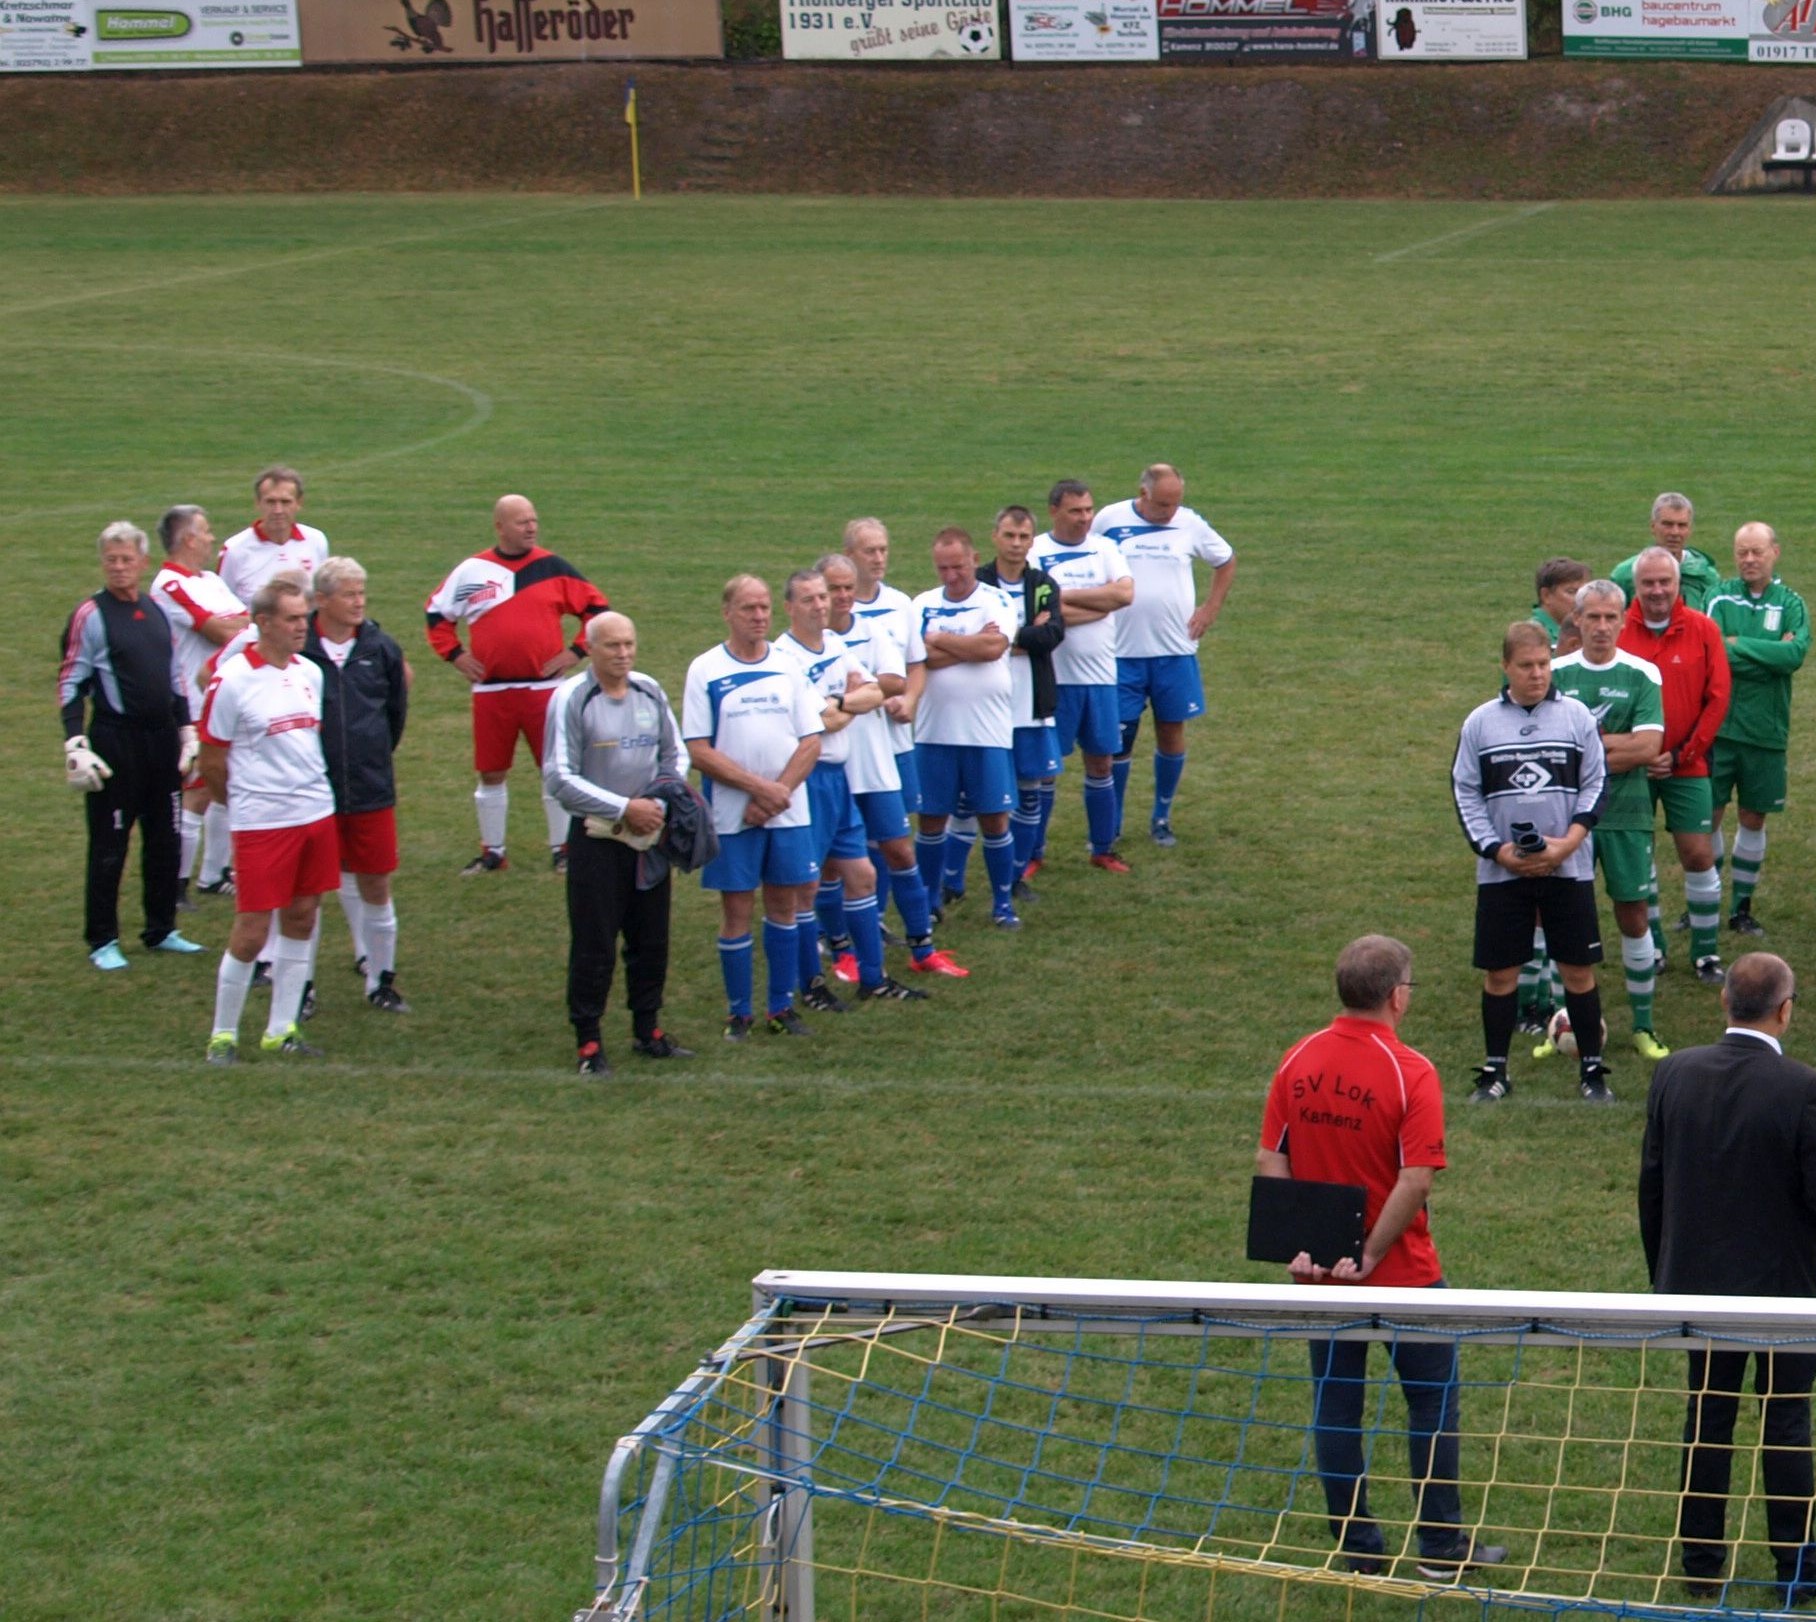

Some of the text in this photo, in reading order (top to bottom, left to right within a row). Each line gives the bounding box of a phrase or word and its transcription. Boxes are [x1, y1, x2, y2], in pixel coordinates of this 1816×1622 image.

[1160, 0, 1309, 14] HOMMEL
[1601, 7, 1632, 17] BHG
[1642, 0, 1721, 12] baucentrum
[790, 13, 877, 29] 1931 e.V.
[1642, 15, 1736, 28] hagebaumarkt
[850, 28, 893, 57] grüßt
[900, 22, 940, 42] seine
[1757, 46, 1798, 59] 01917
[113, 808, 123, 830] 1
[1293, 1073, 1376, 1109] SV Lok
[1300, 1106, 1363, 1132] Kamenz
